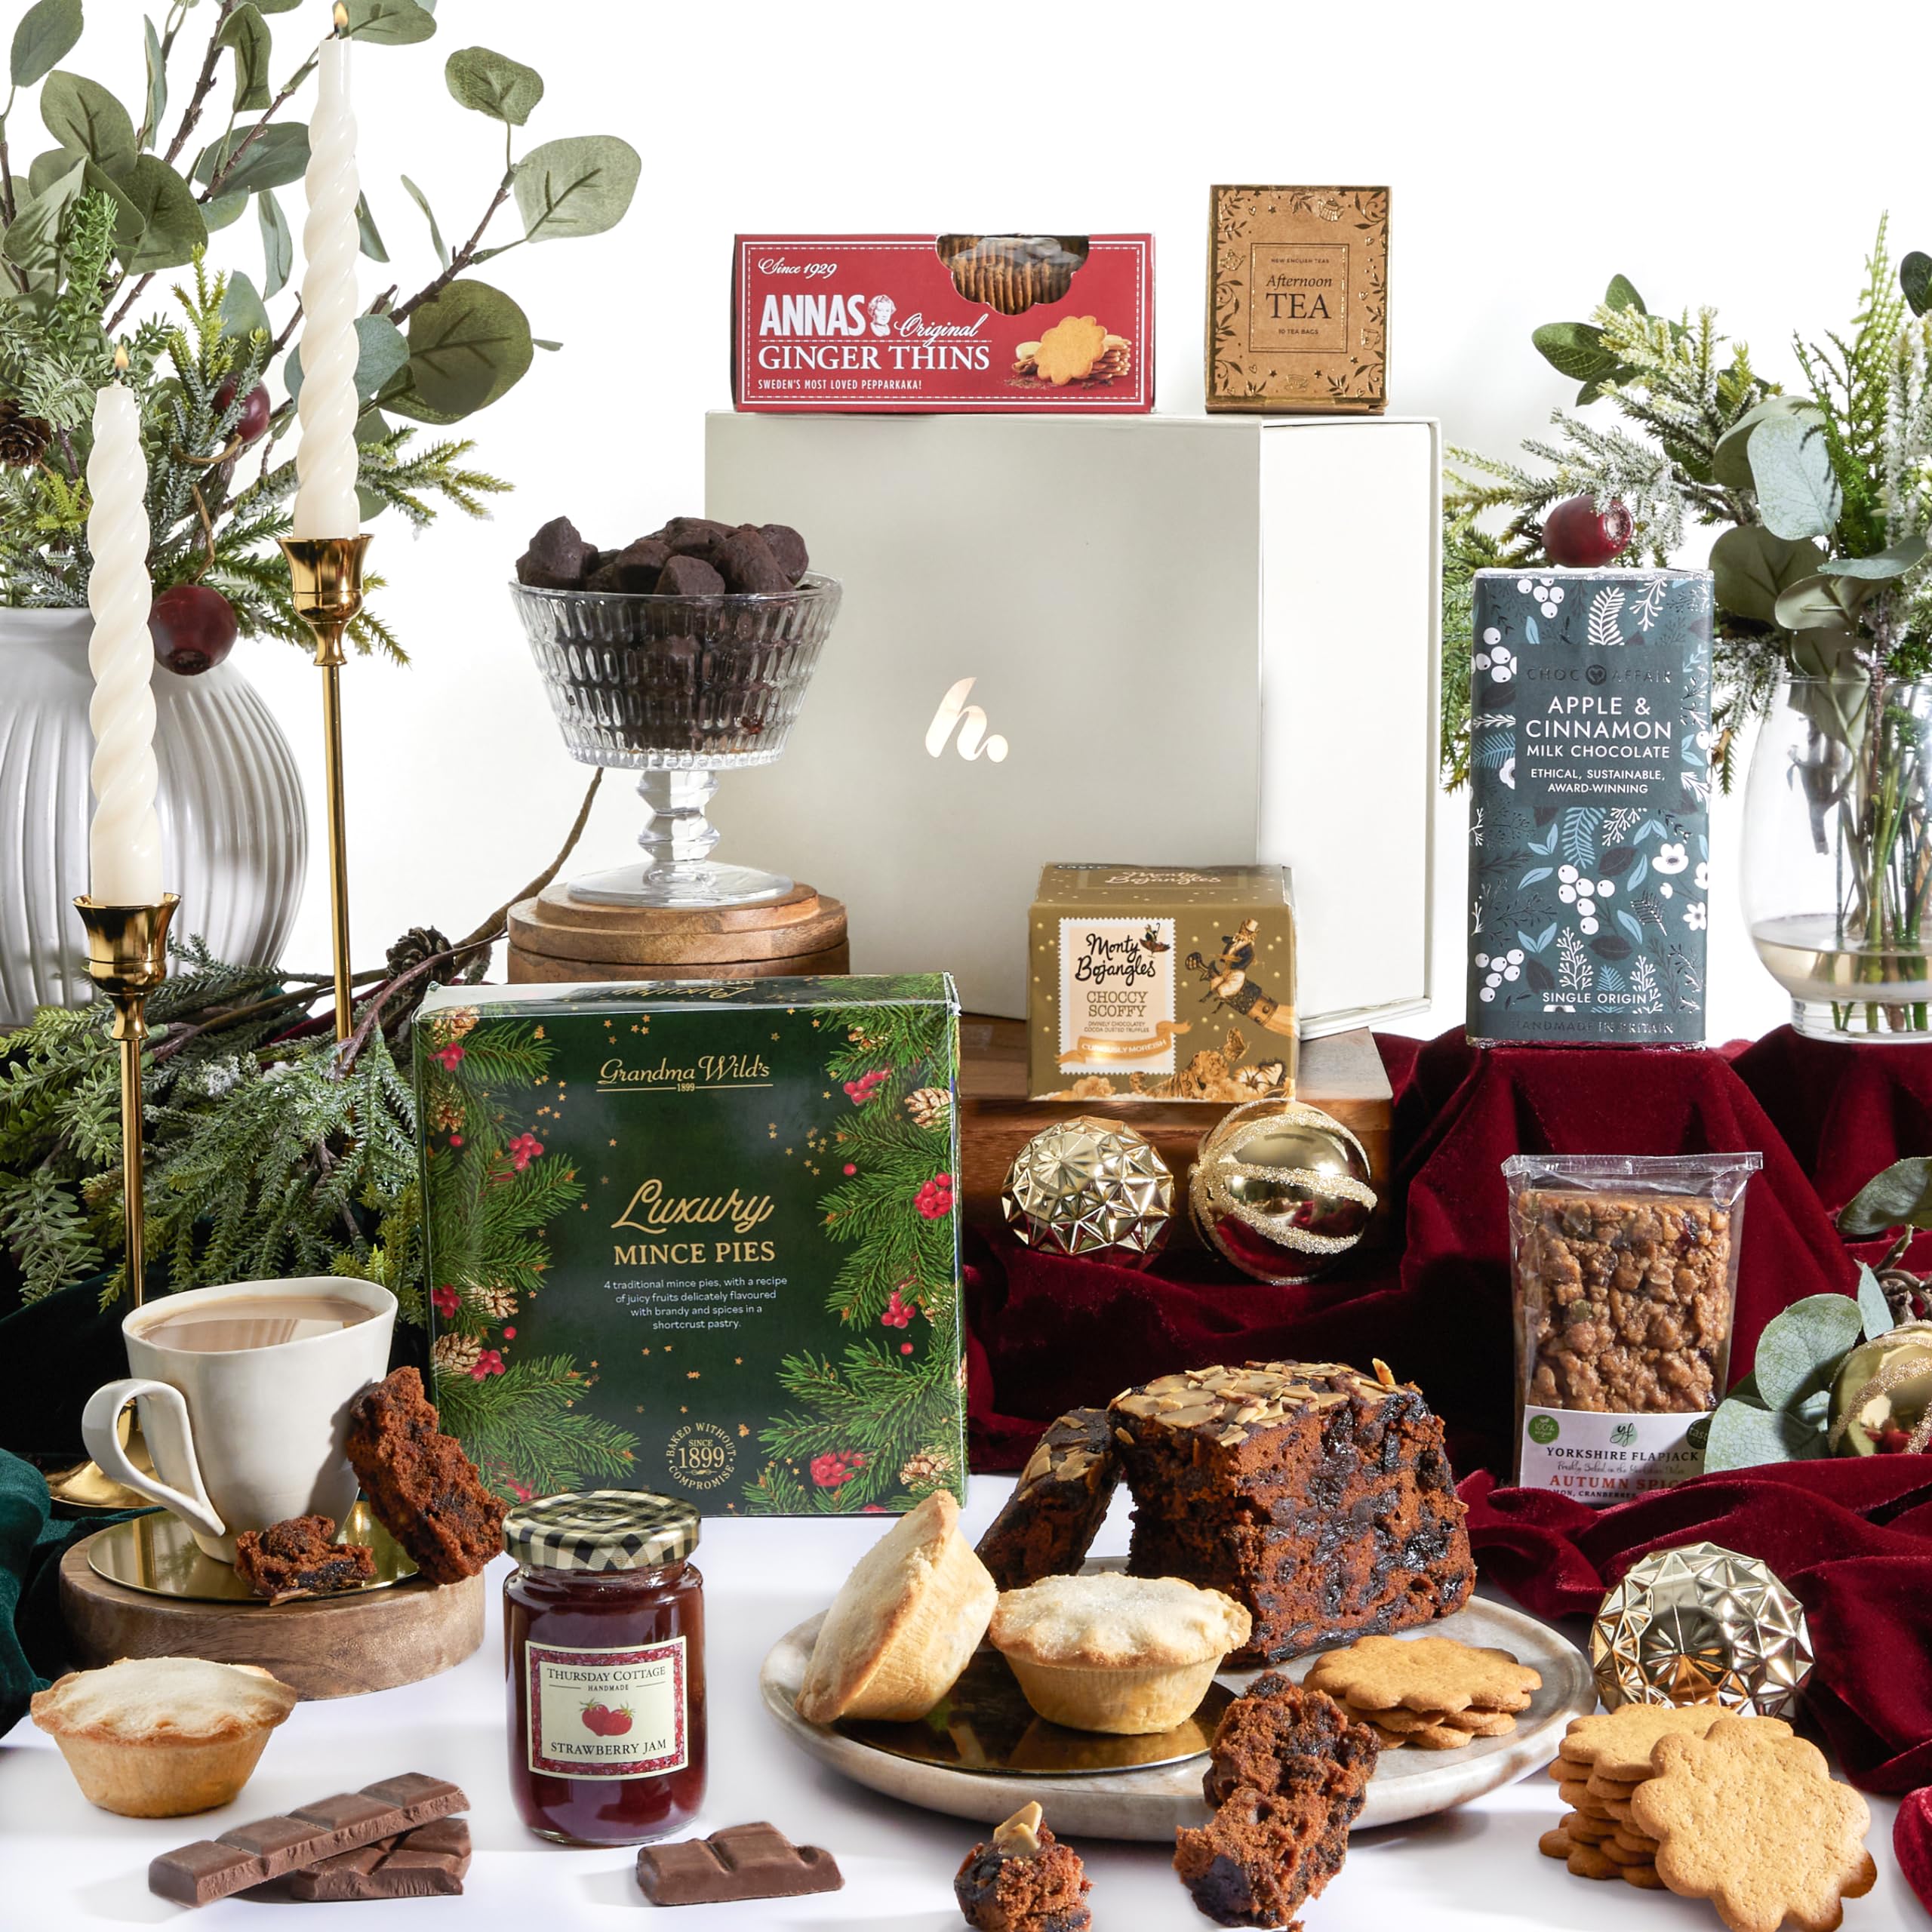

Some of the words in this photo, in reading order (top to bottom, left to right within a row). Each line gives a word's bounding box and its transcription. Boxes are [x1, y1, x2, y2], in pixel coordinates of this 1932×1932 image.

[758, 257, 801, 275] Since
[803, 262, 838, 278] 1929
[1266, 273, 1332, 291] Afternoon
[1266, 292, 1332, 319] TEA
[759, 294, 865, 337] ANNAS
[894, 312, 989, 347] Original
[758, 346, 881, 371] GINGER
[888, 345, 990, 371] THINS
[758, 379, 801, 390] SWEDEN'S
[804, 379, 827, 390] MOST
[830, 379, 858, 390] LOVED
[861, 379, 922, 390] PEPPARKAKA!
[1527, 669, 1580, 681] CHOC
[1611, 670, 1672, 683] AFFAIR
[1548, 696, 1622, 715] APPLE
[1635, 697, 1651, 715] &
[1525, 720, 1672, 740] CINNAMON
[1527, 745, 1563, 757] MILK
[1571, 745, 1670, 758] CHOCOLATE
[1531, 768, 1583, 780] ETHICAL,
[1587, 769, 1666, 781] SUSTAINABLE,
[1548, 783, 1648, 794] AWARD-WINNING
[1086, 933, 1141, 963] Monty
[1075, 954, 1155, 986] Bojangles
[1087, 991, 1148, 1004] CHOCCY
[1543, 992, 1591, 1004] SINGLE
[1598, 992, 1647, 1004] ORIGIN
[1088, 1004, 1146, 1017] SCOFFY
[597, 1058, 696, 1084] Grandma
[698, 1054, 770, 1081] Wild's
[676, 1082, 695, 1092] 1899
[611, 1179, 775, 1234] Luxury
[614, 1243, 706, 1266] MINCE
[715, 1241, 776, 1263] PIES
[604, 1281, 611, 1289] 4
[613, 1279, 664, 1290] traditional
[666, 1278, 696, 1288] mince
[699, 1278, 721, 1290] pies,
[724, 1277, 745, 1287] with
[755, 1276, 788, 1288] recipe
[616, 1294, 626, 1303] of
[626, 1294, 650, 1305] juicy
[652, 1292, 678, 1303] fruits
[681, 1291, 728, 1303] delicately
[730, 1290, 777, 1300] flavoured
[631, 1306, 652, 1317] with
[655, 1306, 689, 1318] brandy
[691, 1305, 710, 1315] and
[712, 1305, 744, 1317] spices
[746, 1305, 754, 1313] in
[653, 1319, 705, 1330] shortcrust
[708, 1319, 741, 1331] pastry.
[666, 1426, 691, 1457] BAKED
[695, 1423, 737, 1457] WITHOUT
[678, 1447, 724, 1469] 1899
[1546, 1447, 1627, 1460] YORKSHIRE
[1632, 1452, 1699, 1462] FLAPJACK
[669, 1465, 735, 1490] COMPROMISE
[1549, 1475, 1629, 1490] AUTUMN
[547, 1667, 611, 1682] THURSDAY
[614, 1666, 666, 1681] COTTAGE
[551, 1742, 639, 1755] STRAWBERRY
[643, 1739, 666, 1755] JAM
